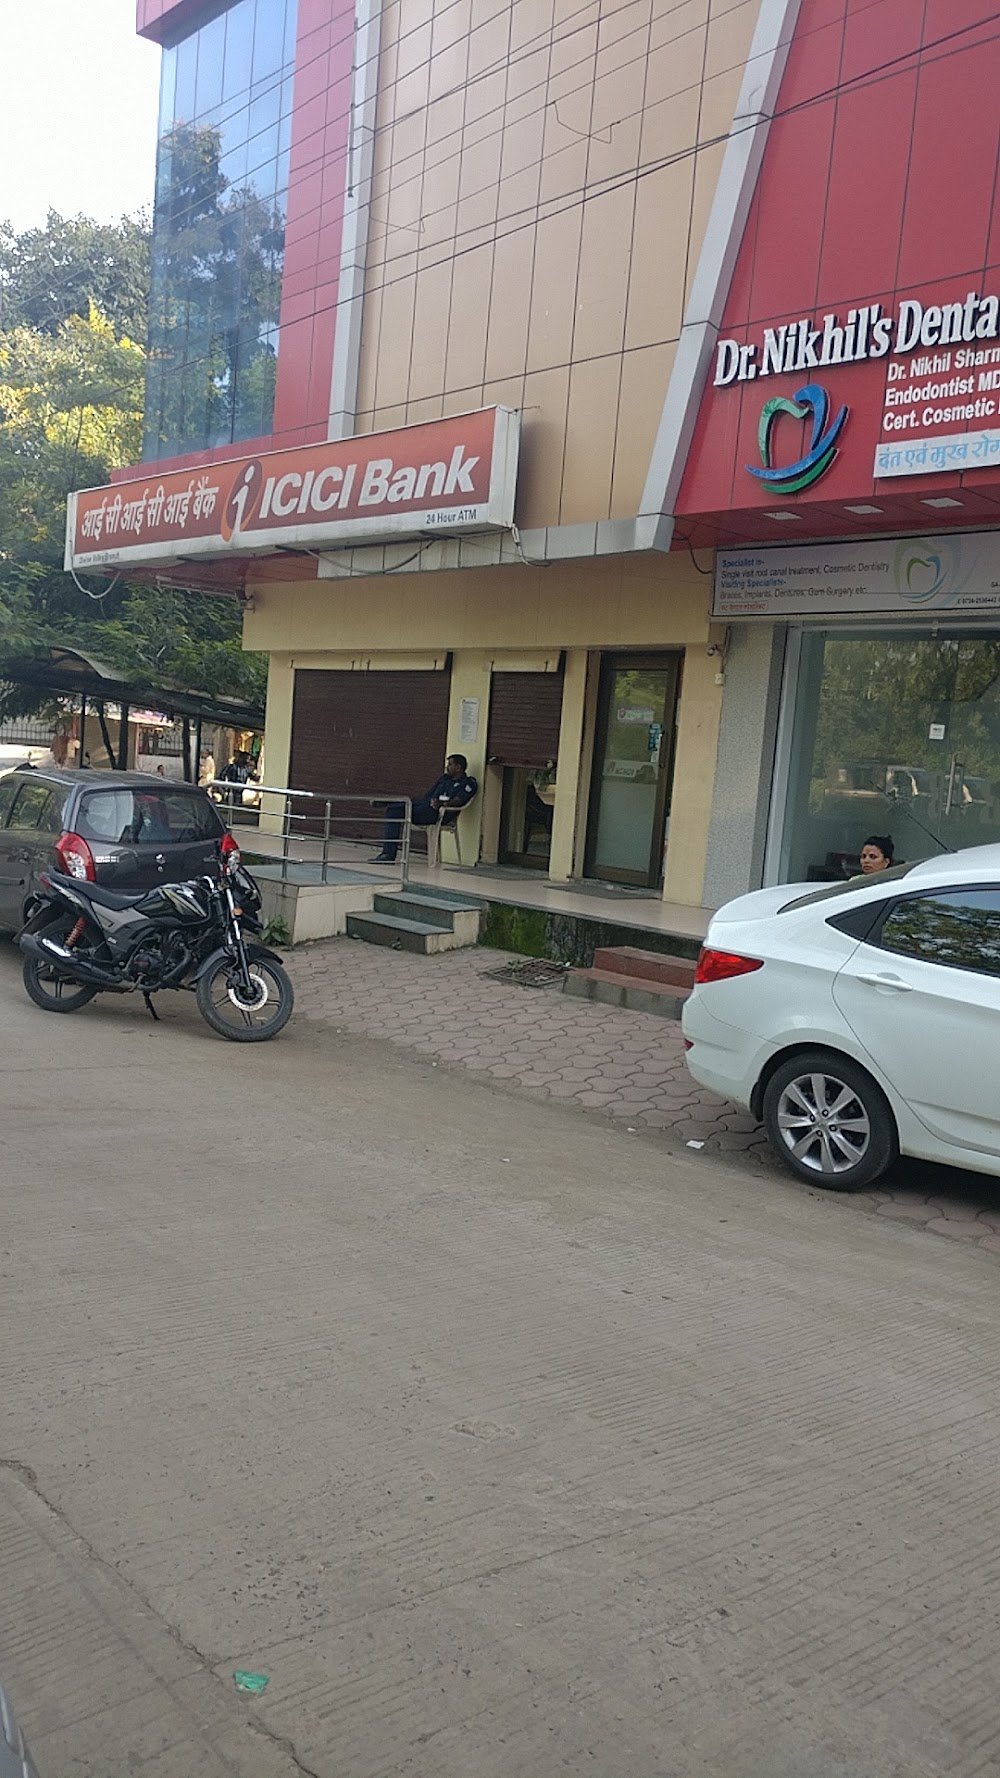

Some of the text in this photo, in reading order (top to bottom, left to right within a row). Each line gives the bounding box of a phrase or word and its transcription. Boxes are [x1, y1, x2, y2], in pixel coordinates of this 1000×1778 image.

[713, 291, 999, 387] Dr. Nikhil's Denta
[888, 363, 907, 382] Dr.
[910, 352, 951, 378] Nikhil
[884, 375, 975, 407] Endodontist
[883, 410, 919, 432] Cert.
[922, 398, 995, 427] Cosmetic
[930, 443, 969, 469] मुख
[258, 463, 357, 520] ICICI
[357, 444, 481, 507] Bank
[81, 476, 220, 542] आई सी आई सी आई बैंक
[426, 509, 477, 525] 24 Hour ATM
[755, 568, 768, 577] root
[823, 563, 857, 574] Cosmetic
